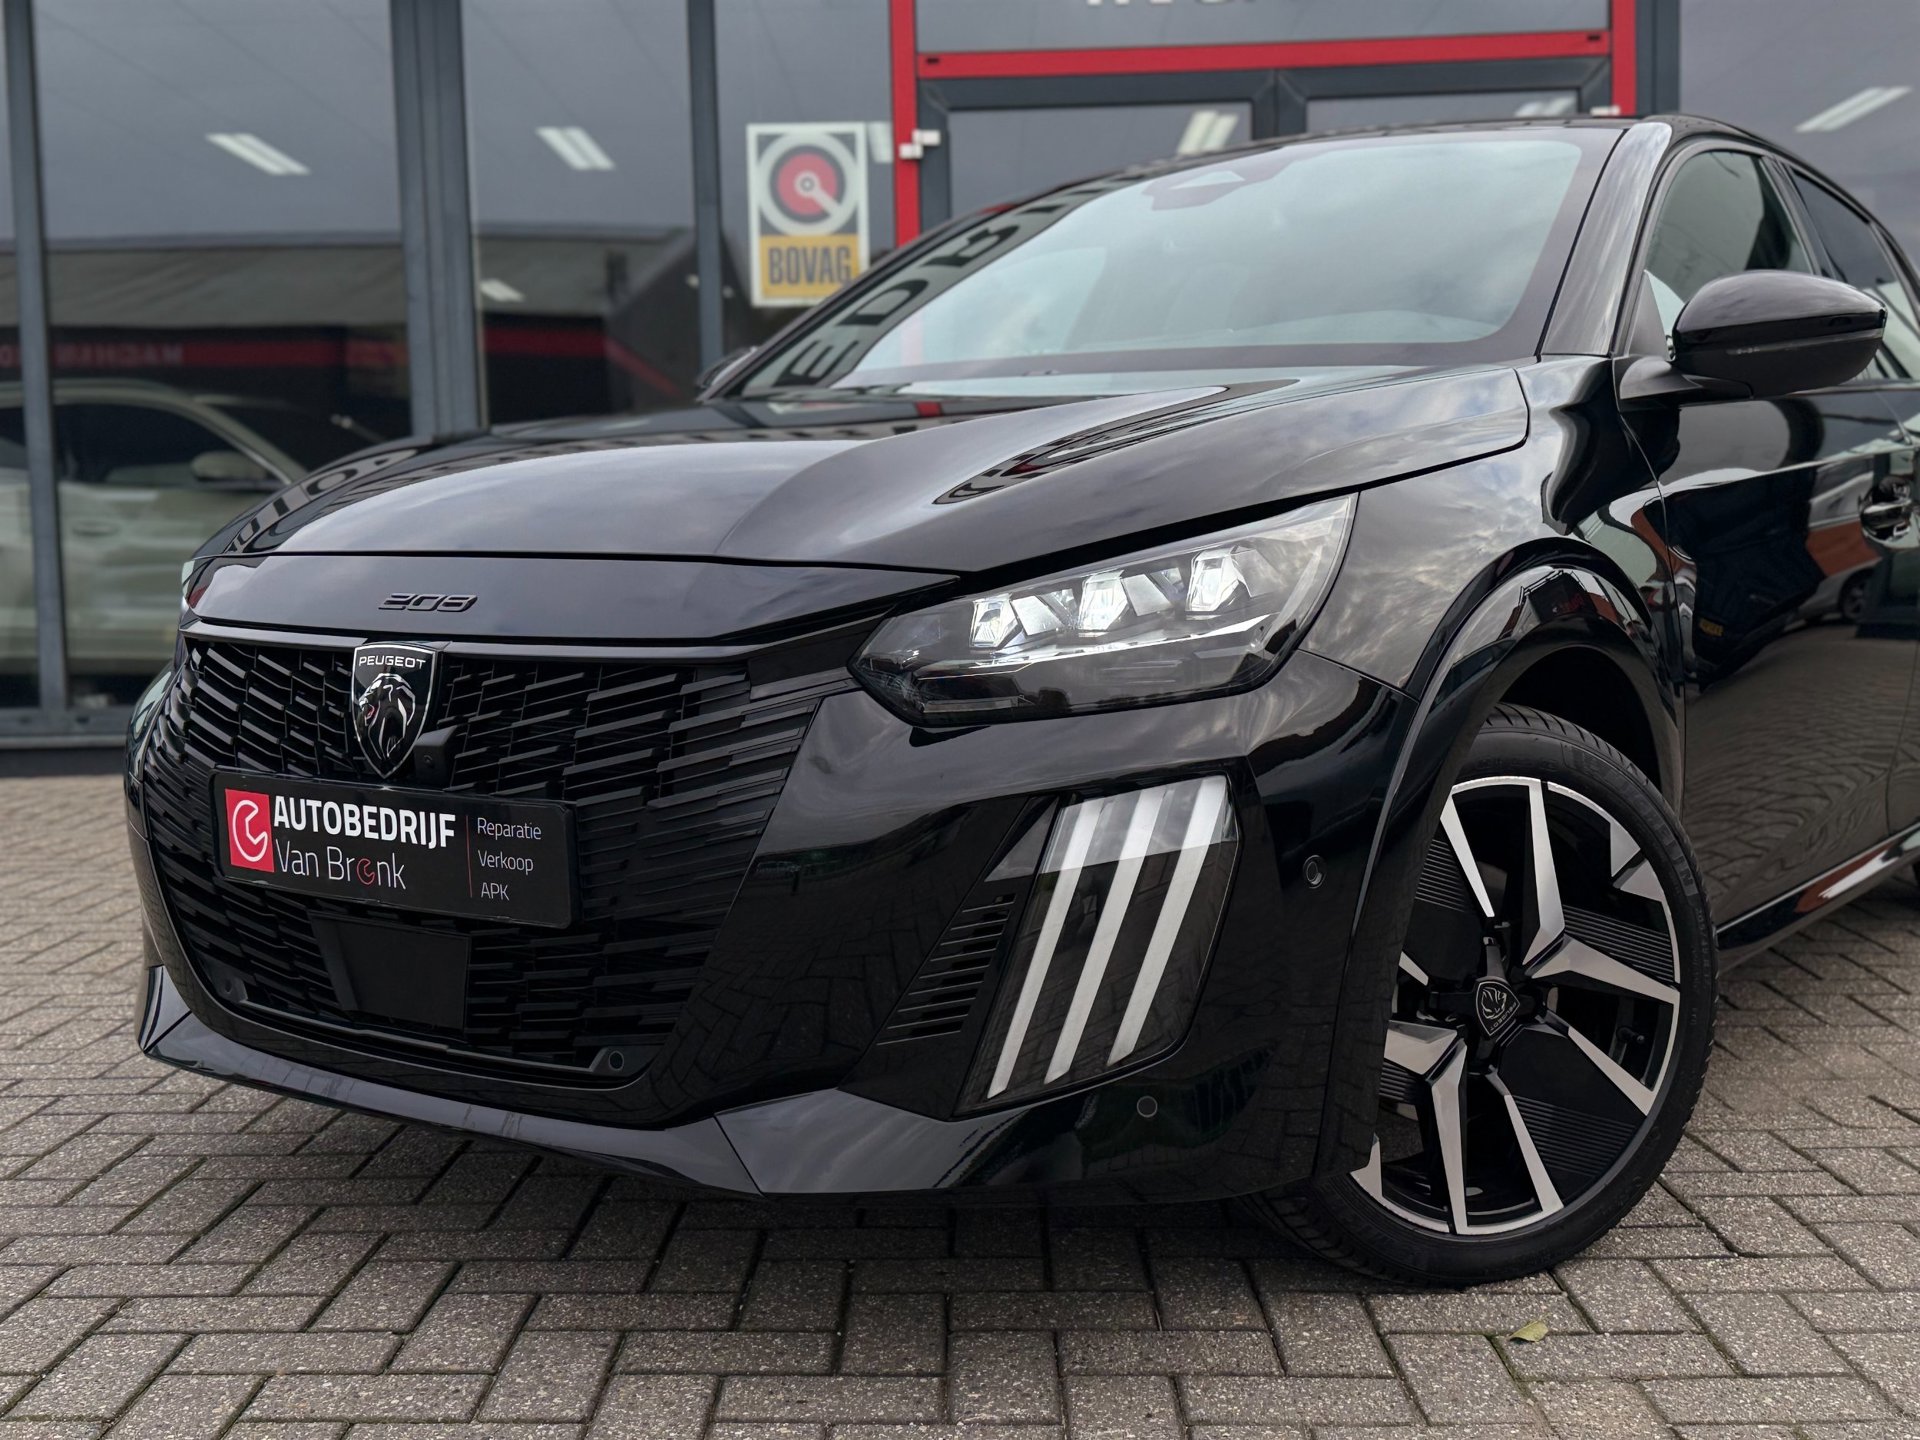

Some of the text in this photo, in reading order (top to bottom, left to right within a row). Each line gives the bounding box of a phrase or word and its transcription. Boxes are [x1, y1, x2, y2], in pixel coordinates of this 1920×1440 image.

[767, 245, 854, 286] BOVAG
[378, 592, 478, 612] 208
[358, 655, 426, 670] PEUGEOT
[273, 795, 456, 850] AUTOBEDRIJF
[477, 817, 542, 840] Reparatie
[275, 839, 320, 878] Van
[477, 849, 534, 876] Verkoop
[480, 882, 510, 901] APK
